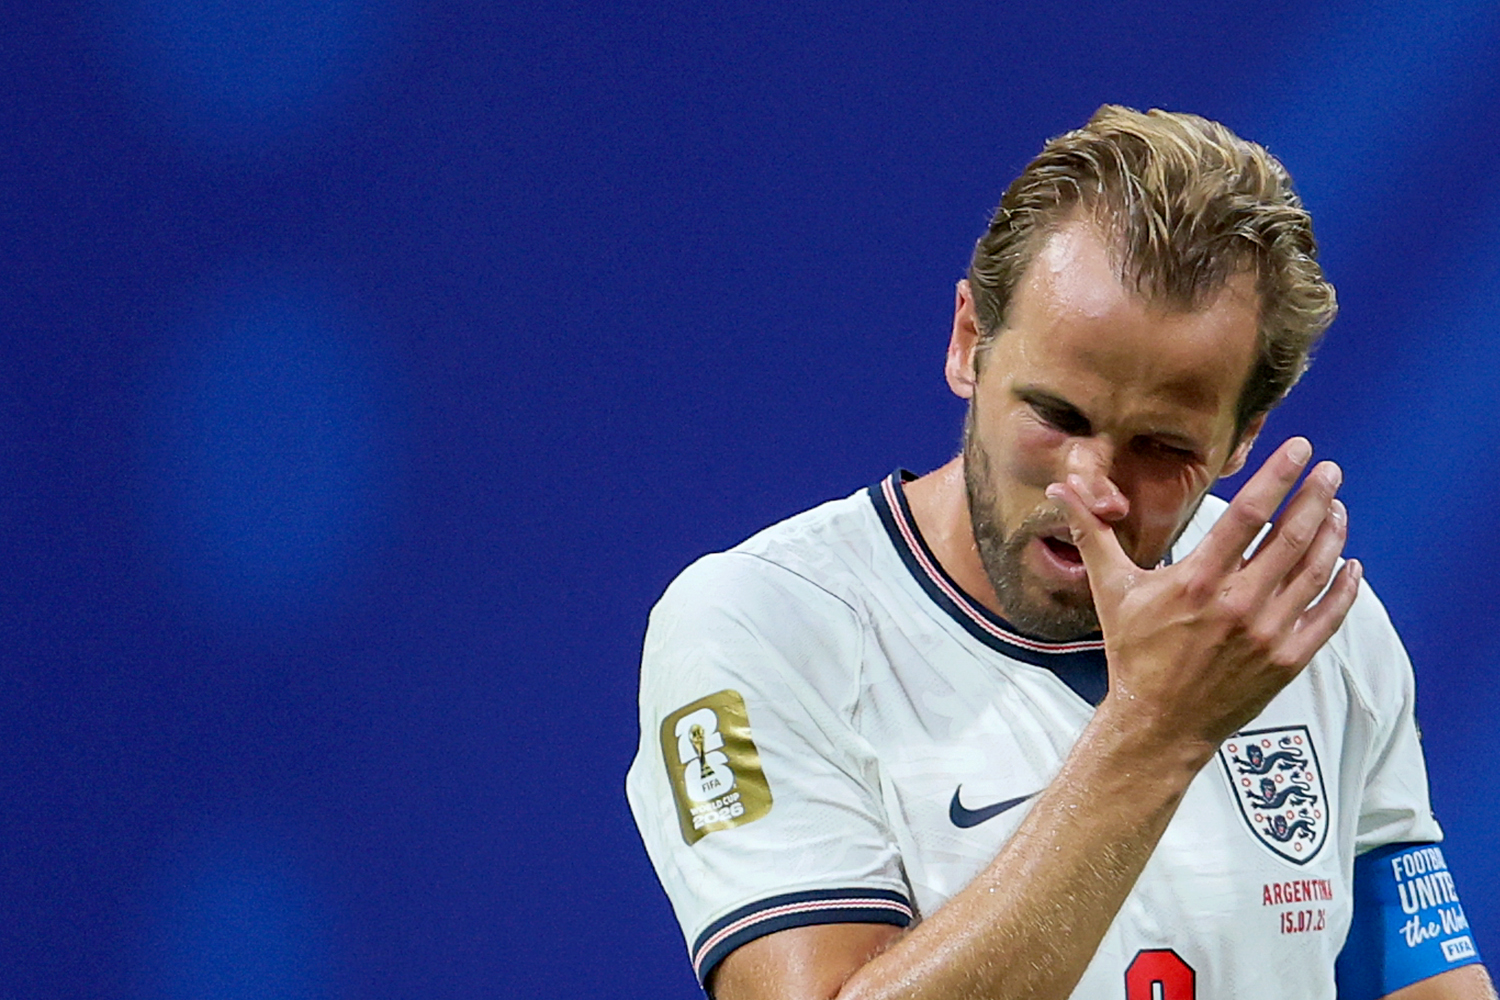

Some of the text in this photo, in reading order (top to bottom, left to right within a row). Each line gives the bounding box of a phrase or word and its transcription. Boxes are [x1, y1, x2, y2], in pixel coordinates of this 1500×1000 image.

[702, 778, 721, 793] FIFA
[690, 792, 740, 816] WORLD CUP
[692, 802, 745, 830] 2026
[1400, 915, 1441, 948] the
[1447, 940, 1473, 957] FIFA
